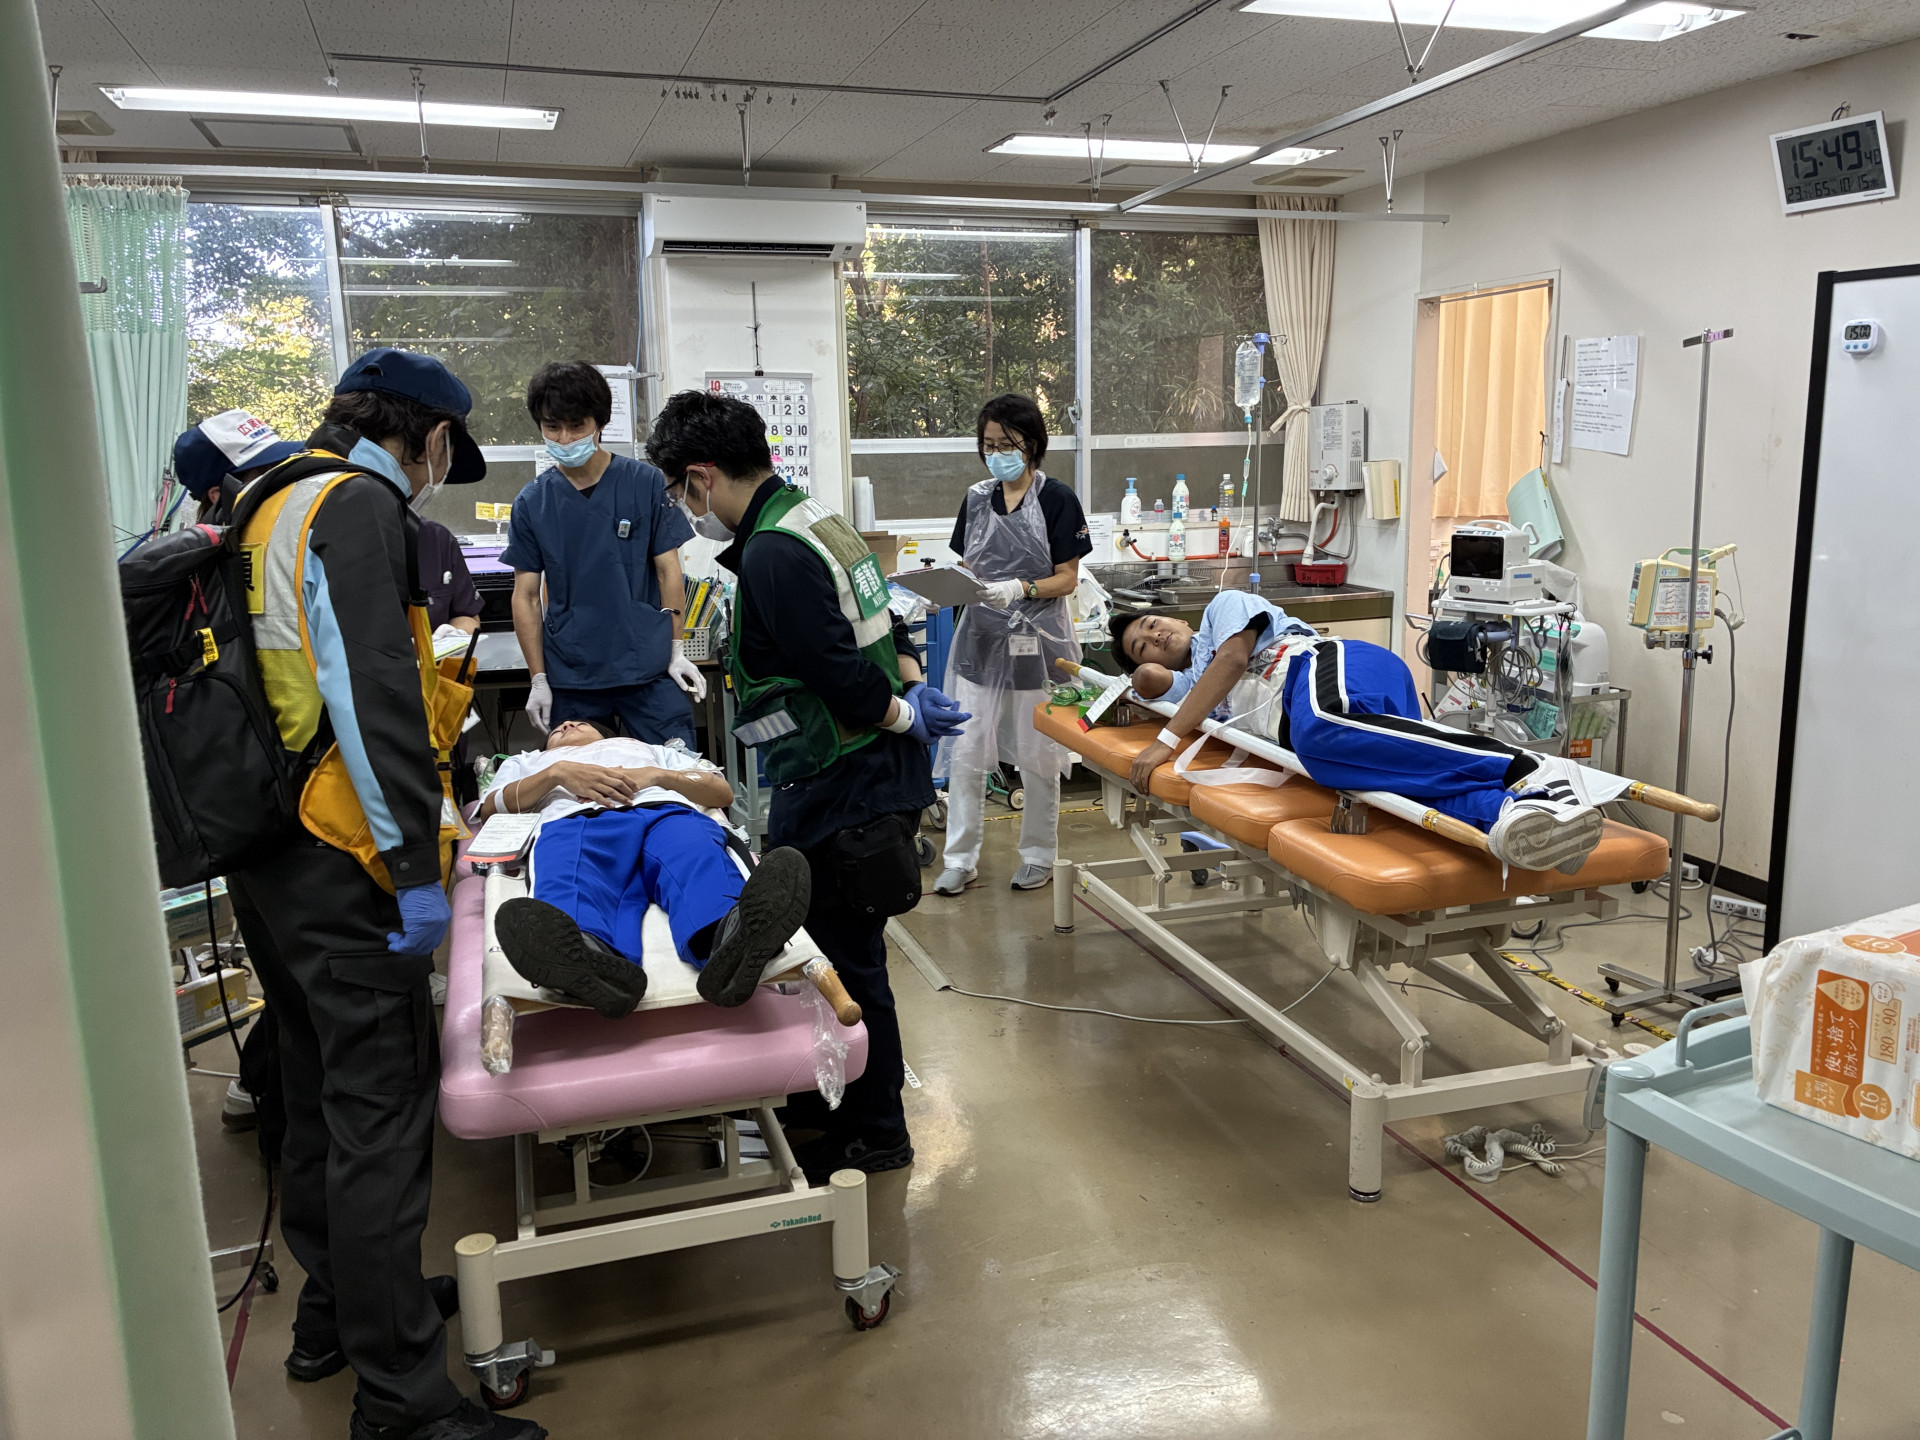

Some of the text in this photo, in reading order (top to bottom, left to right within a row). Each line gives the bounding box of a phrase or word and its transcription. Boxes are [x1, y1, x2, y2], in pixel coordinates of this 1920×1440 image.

[1791, 130, 1863, 179] 15:49
[772, 404, 806, 415] 1 2 3
[771, 425, 808, 436] 8 9 10
[771, 446, 808, 456] 15 16 17
[798, 466, 808, 476] 24
[1824, 1010, 1845, 1073] 使い捨て
[1843, 1018, 1860, 1079] 防水シーツ
[1880, 1036, 1896, 1060] 180
[1813, 1080, 1828, 1107] 大判
[1860, 1090, 1880, 1113] 16
